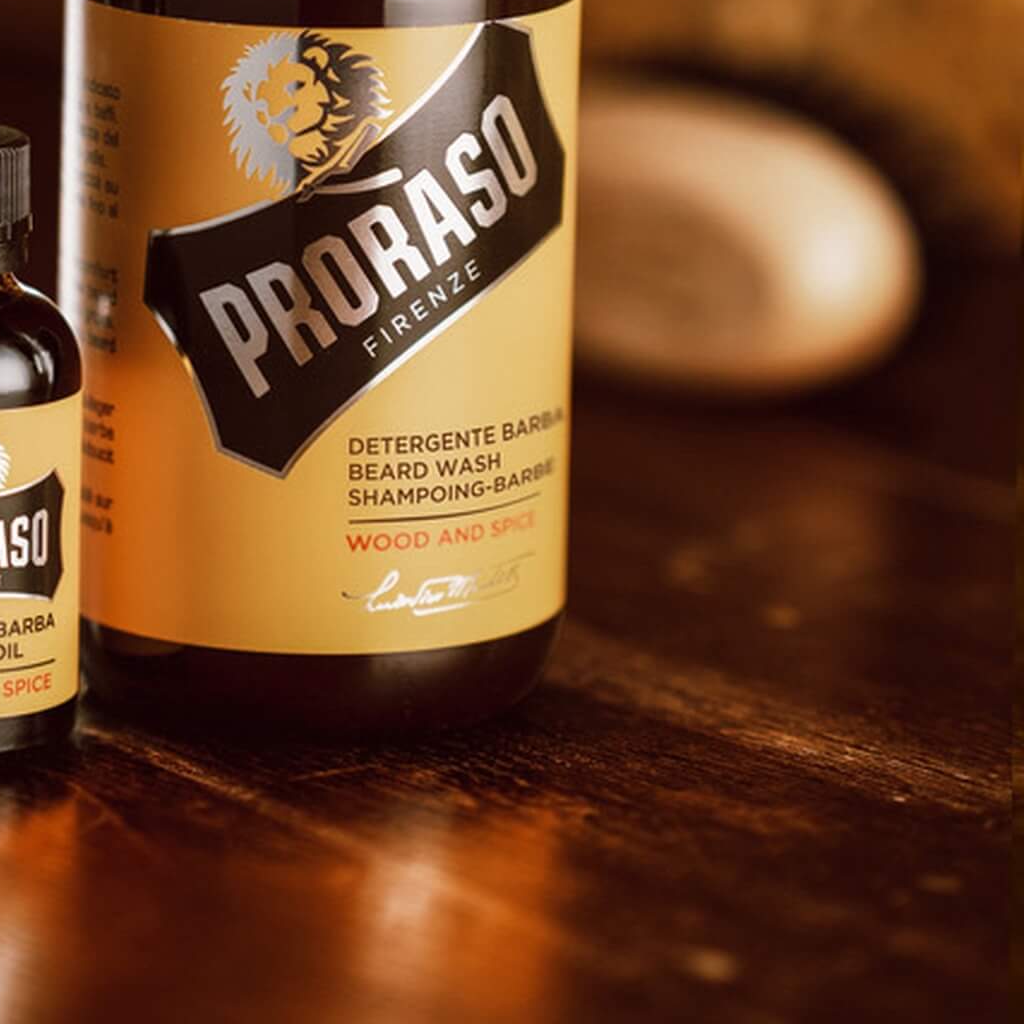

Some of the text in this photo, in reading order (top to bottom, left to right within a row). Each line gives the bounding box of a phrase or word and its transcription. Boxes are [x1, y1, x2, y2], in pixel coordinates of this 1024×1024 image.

[199, 94, 538, 398] PRORASO
[362, 258, 481, 358] FIRENZE
[348, 426, 496, 456] DETERGENTE
[348, 452, 502, 481] BEARD WASH
[345, 531, 430, 553] WOOD
[438, 524, 486, 547] AND
[3, 672, 53, 695] SPICE
